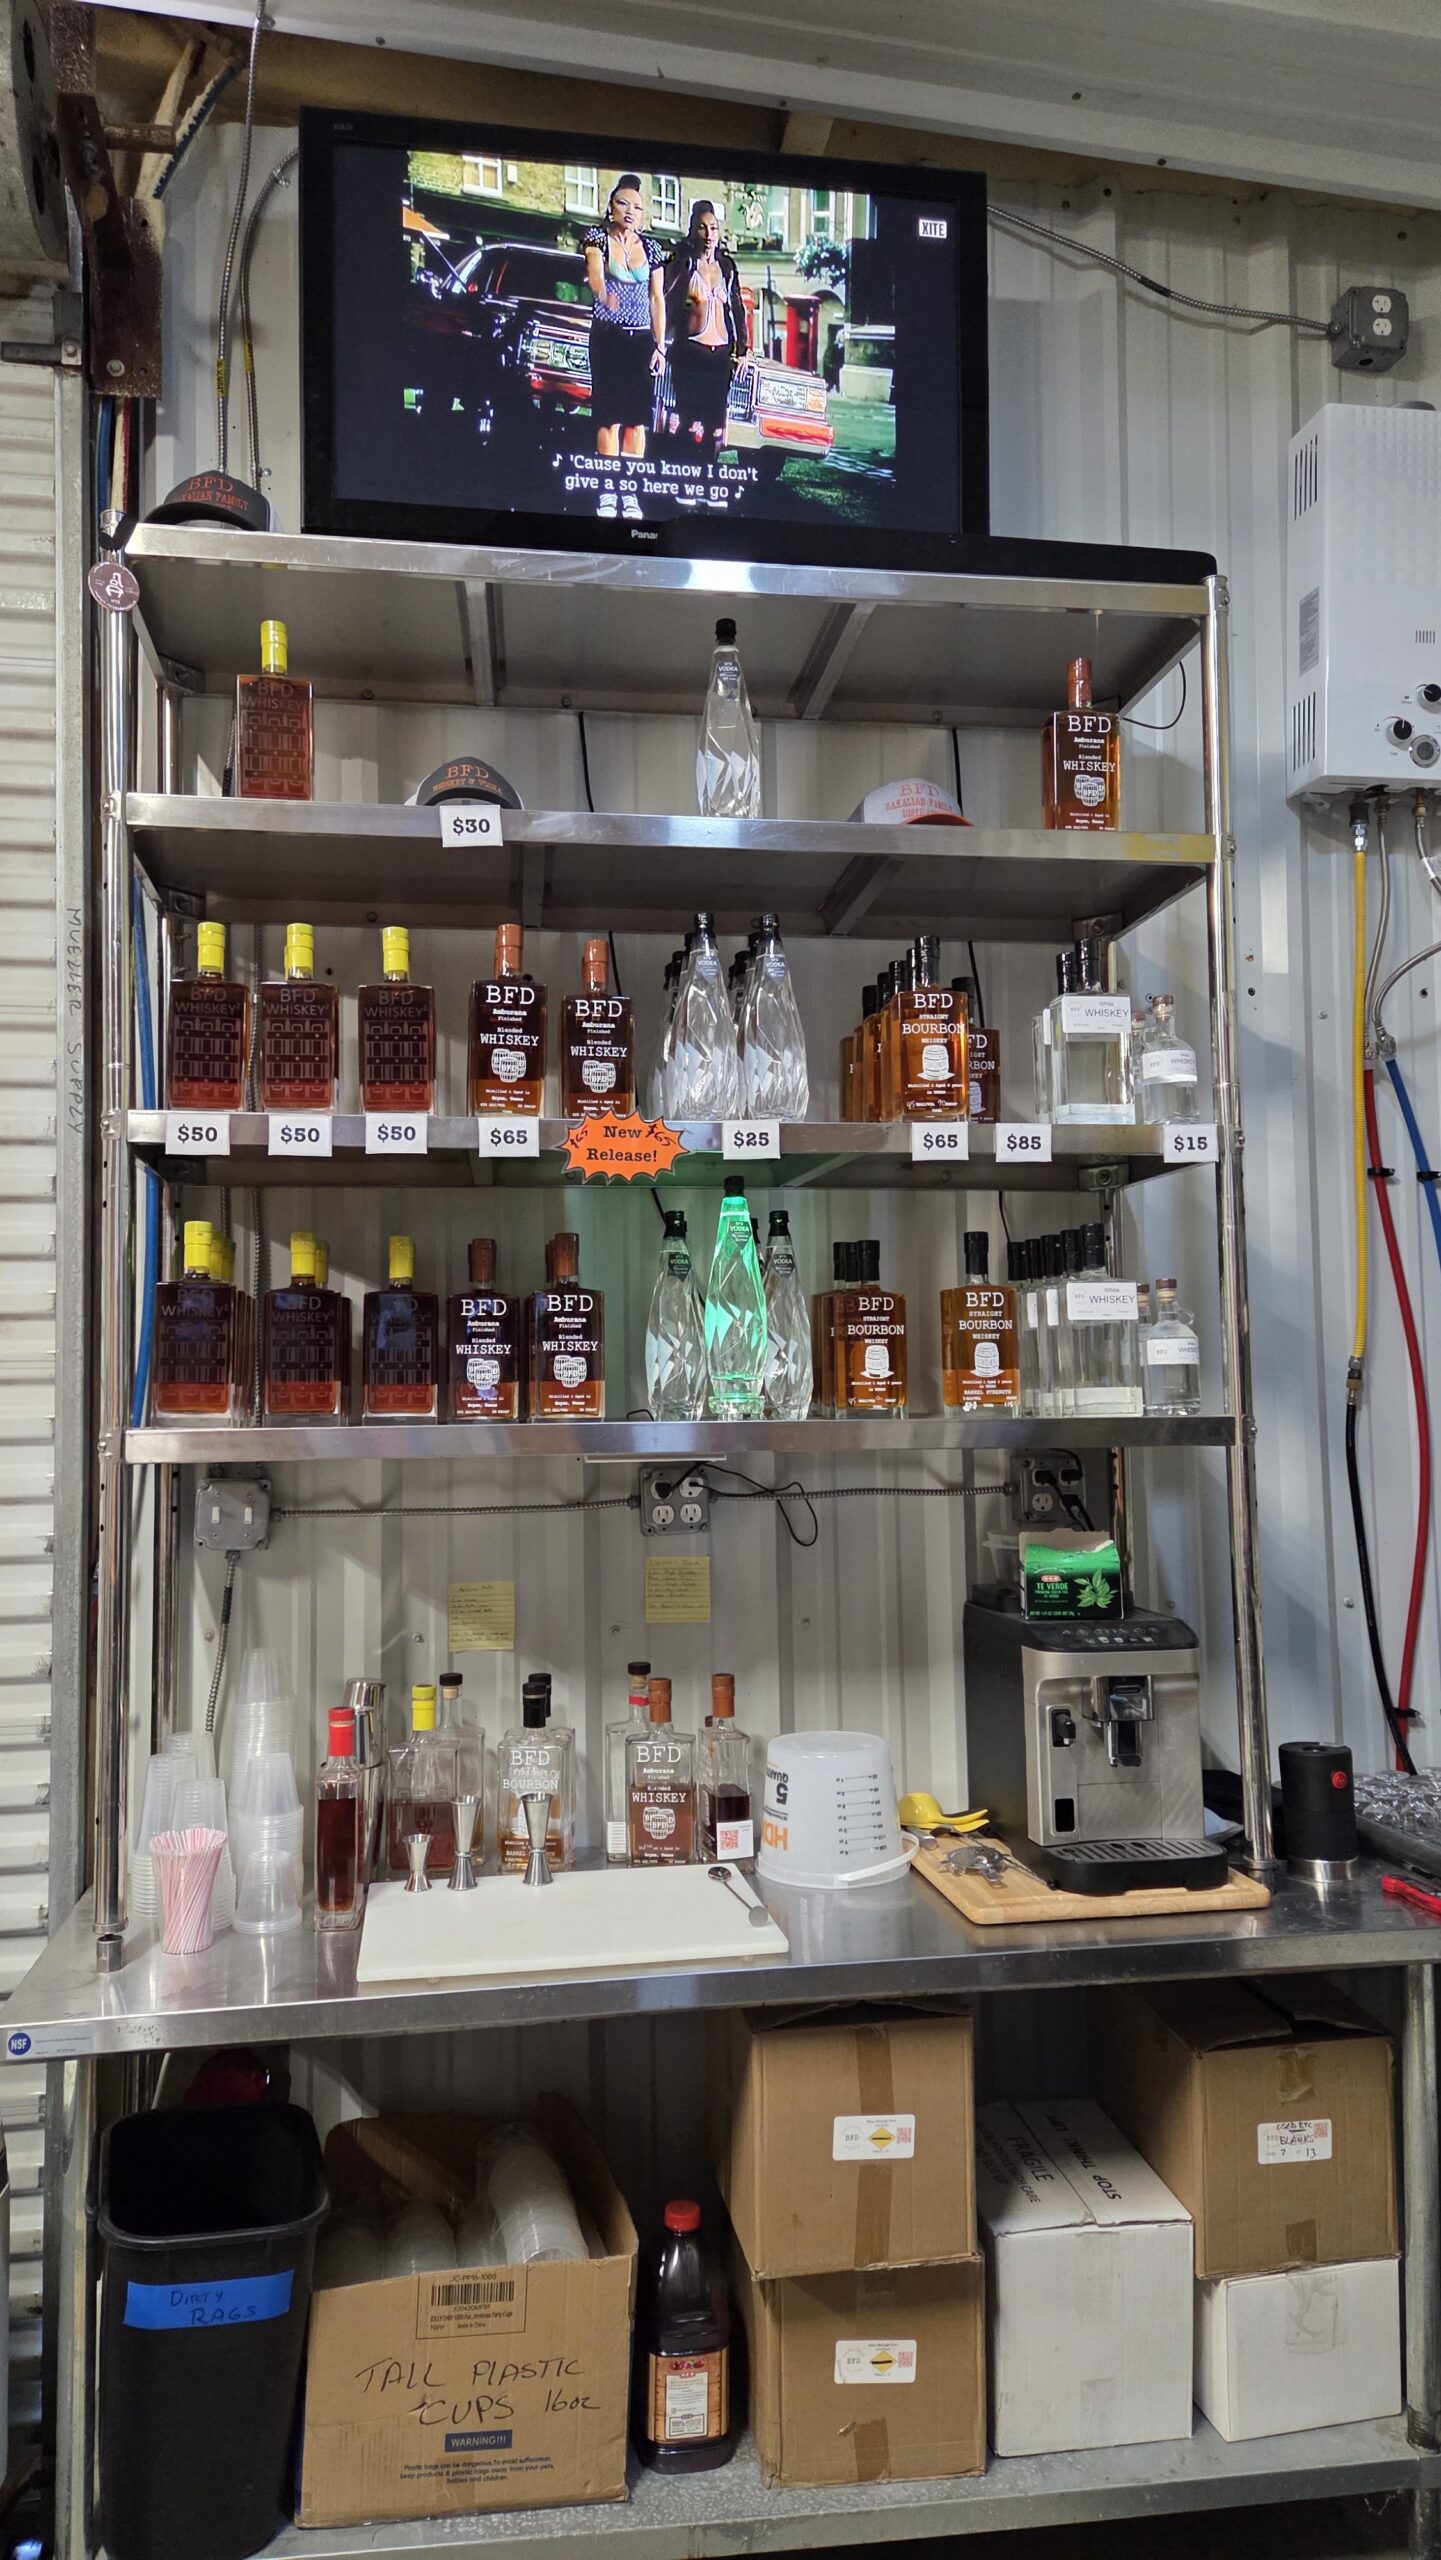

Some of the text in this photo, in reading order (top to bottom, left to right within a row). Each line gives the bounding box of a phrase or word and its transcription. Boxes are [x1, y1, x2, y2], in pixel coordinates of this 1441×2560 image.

[922, 221, 945, 237] XITE
[569, 455, 759, 482] 'Cause you know I don't
[186, 476, 233, 492] BFD
[565, 473, 729, 500] give a so here we go
[1067, 715, 1111, 733] BFD
[446, 764, 489, 779] BFD
[1063, 760, 1116, 772] WHISKEY
[453, 816, 490, 836] $30
[280, 988, 316, 1003] BFD
[379, 991, 414, 1005] BFD
[486, 985, 535, 1005] BFD
[913, 993, 953, 1008] BFD
[575, 999, 622, 1017] BFD
[1084, 1008, 1129, 1017] WHISKEY
[67, 908, 83, 1134] MUELLER SUPPLY
[902, 1023, 965, 1034] BOURBON
[480, 1033, 539, 1046] WHISKEY
[968, 1034, 988, 1048] FD
[570, 1046, 628, 1057] WHISKEY
[177, 1124, 218, 1144] $50
[280, 1125, 319, 1145] $50
[377, 1124, 416, 1143] $50
[490, 1128, 528, 1147] $65
[603, 1126, 642, 1138] New
[734, 1130, 769, 1149] $25
[923, 1132, 958, 1151] $65
[1007, 1134, 1042, 1152] $85
[1174, 1135, 1208, 1153] $15
[587, 1148, 657, 1162] Release!
[547, 1295, 593, 1312] BFD
[858, 1297, 894, 1311] BFD
[966, 1292, 1005, 1307] BFD
[1089, 1295, 1135, 1304] WHISKEY
[461, 1299, 507, 1316] BFD
[847, 1324, 905, 1335] BOURBON
[959, 1320, 1013, 1330] BOURBON
[456, 1344, 512, 1355] WHISKEY
[542, 1341, 598, 1351] WHISKEY
[511, 1750, 550, 1765] BFD
[636, 1745, 681, 1762] BFD
[503, 1779, 559, 1789] BOURBON
[632, 1792, 686, 1803] WHISKEY
[776, 1783, 788, 1805] 5
[11, 2038, 27, 2050] NSF
[1008, 2136, 1054, 2181] FRAGILE
[1306, 2148, 1316, 2159] 13
[1093, 2174, 1122, 2200] STOP
[191, 2305, 256, 2325] RAGS
[355, 2357, 584, 2393] TALL PLASTIC
[418, 2389, 601, 2425] CUPS 16oz
[451, 2435, 506, 2447] WARNING!!!
[416, 2470, 444, 2479] products
[452, 2469, 472, 2477] plastic
[474, 2468, 490, 2476] bags
[424, 2463, 439, 2471] bags
[447, 2476, 468, 2484] babies
